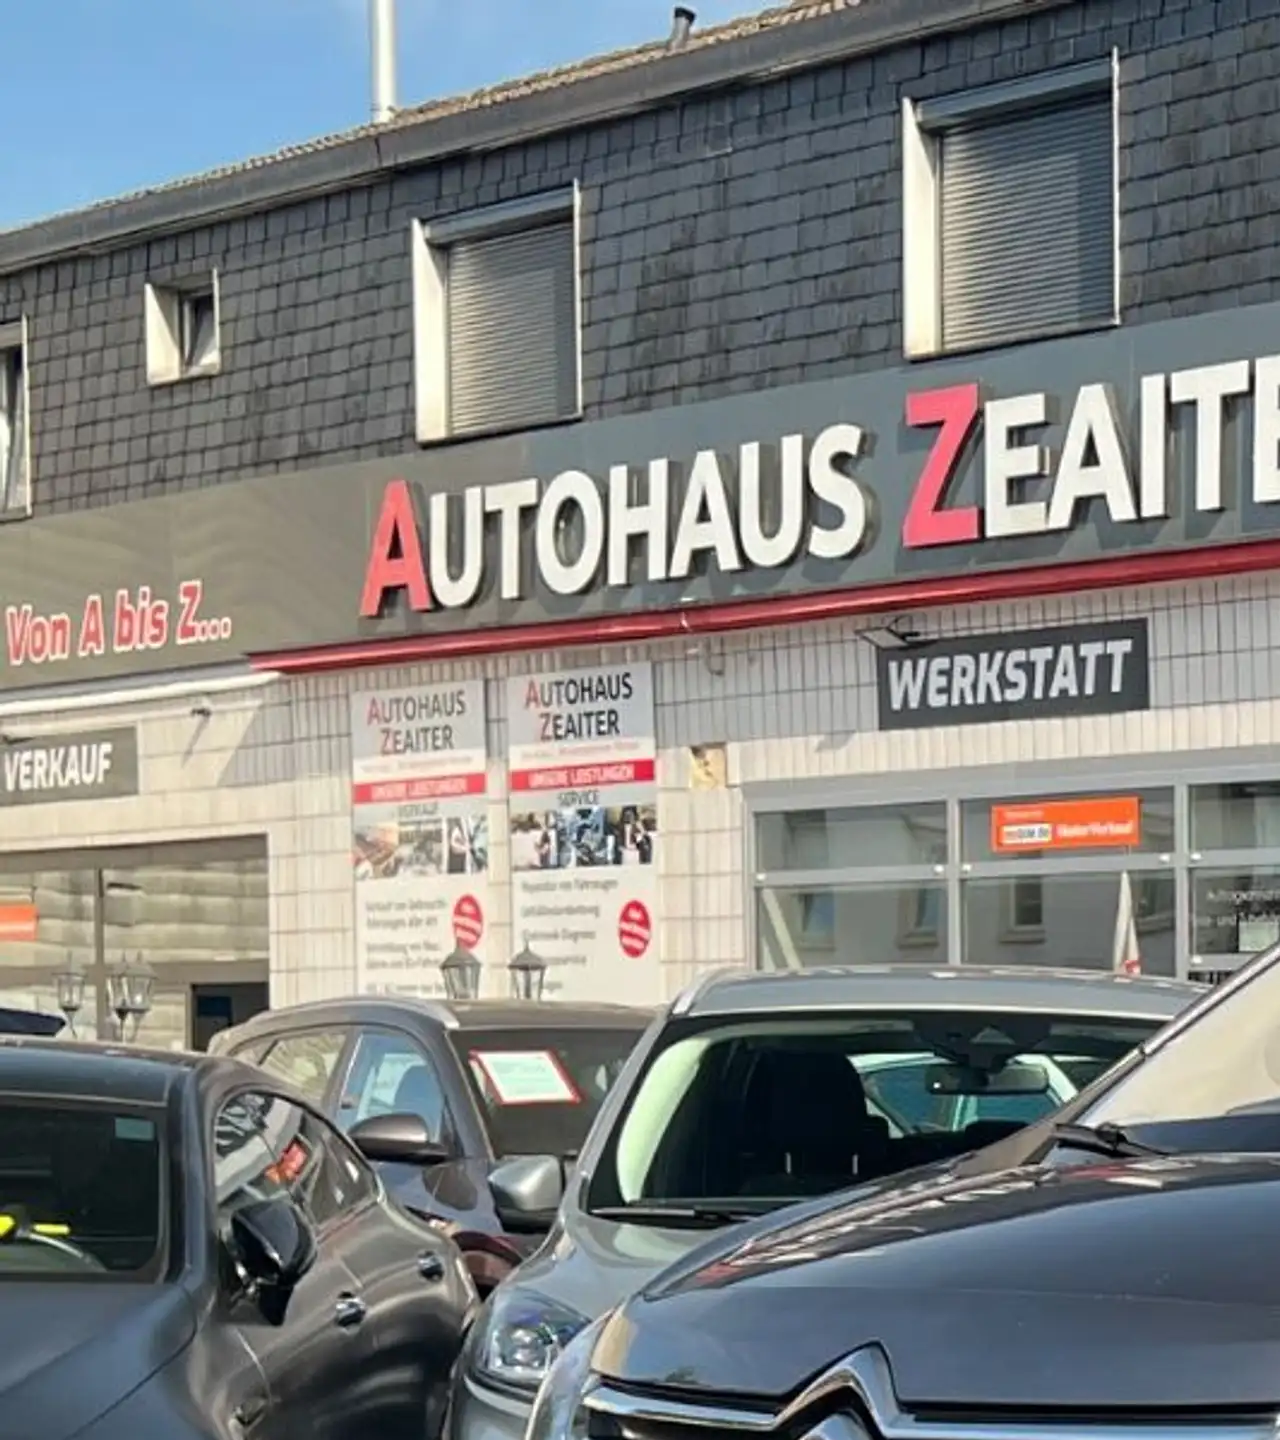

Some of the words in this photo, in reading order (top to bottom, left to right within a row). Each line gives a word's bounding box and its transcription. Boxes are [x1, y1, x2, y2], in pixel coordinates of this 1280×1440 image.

[359, 423, 870, 618] AUTOHAUS
[5, 603, 72, 667] Von
[78, 594, 105, 657] A
[113, 585, 169, 653] bis
[175, 578, 233, 646] Z...
[525, 671, 634, 709] AUTOHAUS
[887, 638, 1133, 711] WERKSTATT
[366, 689, 466, 726] AUTOHAUS
[539, 708, 621, 741] ZEAITER
[380, 723, 454, 756] ZEAITER
[3, 741, 113, 793] VERKAUF
